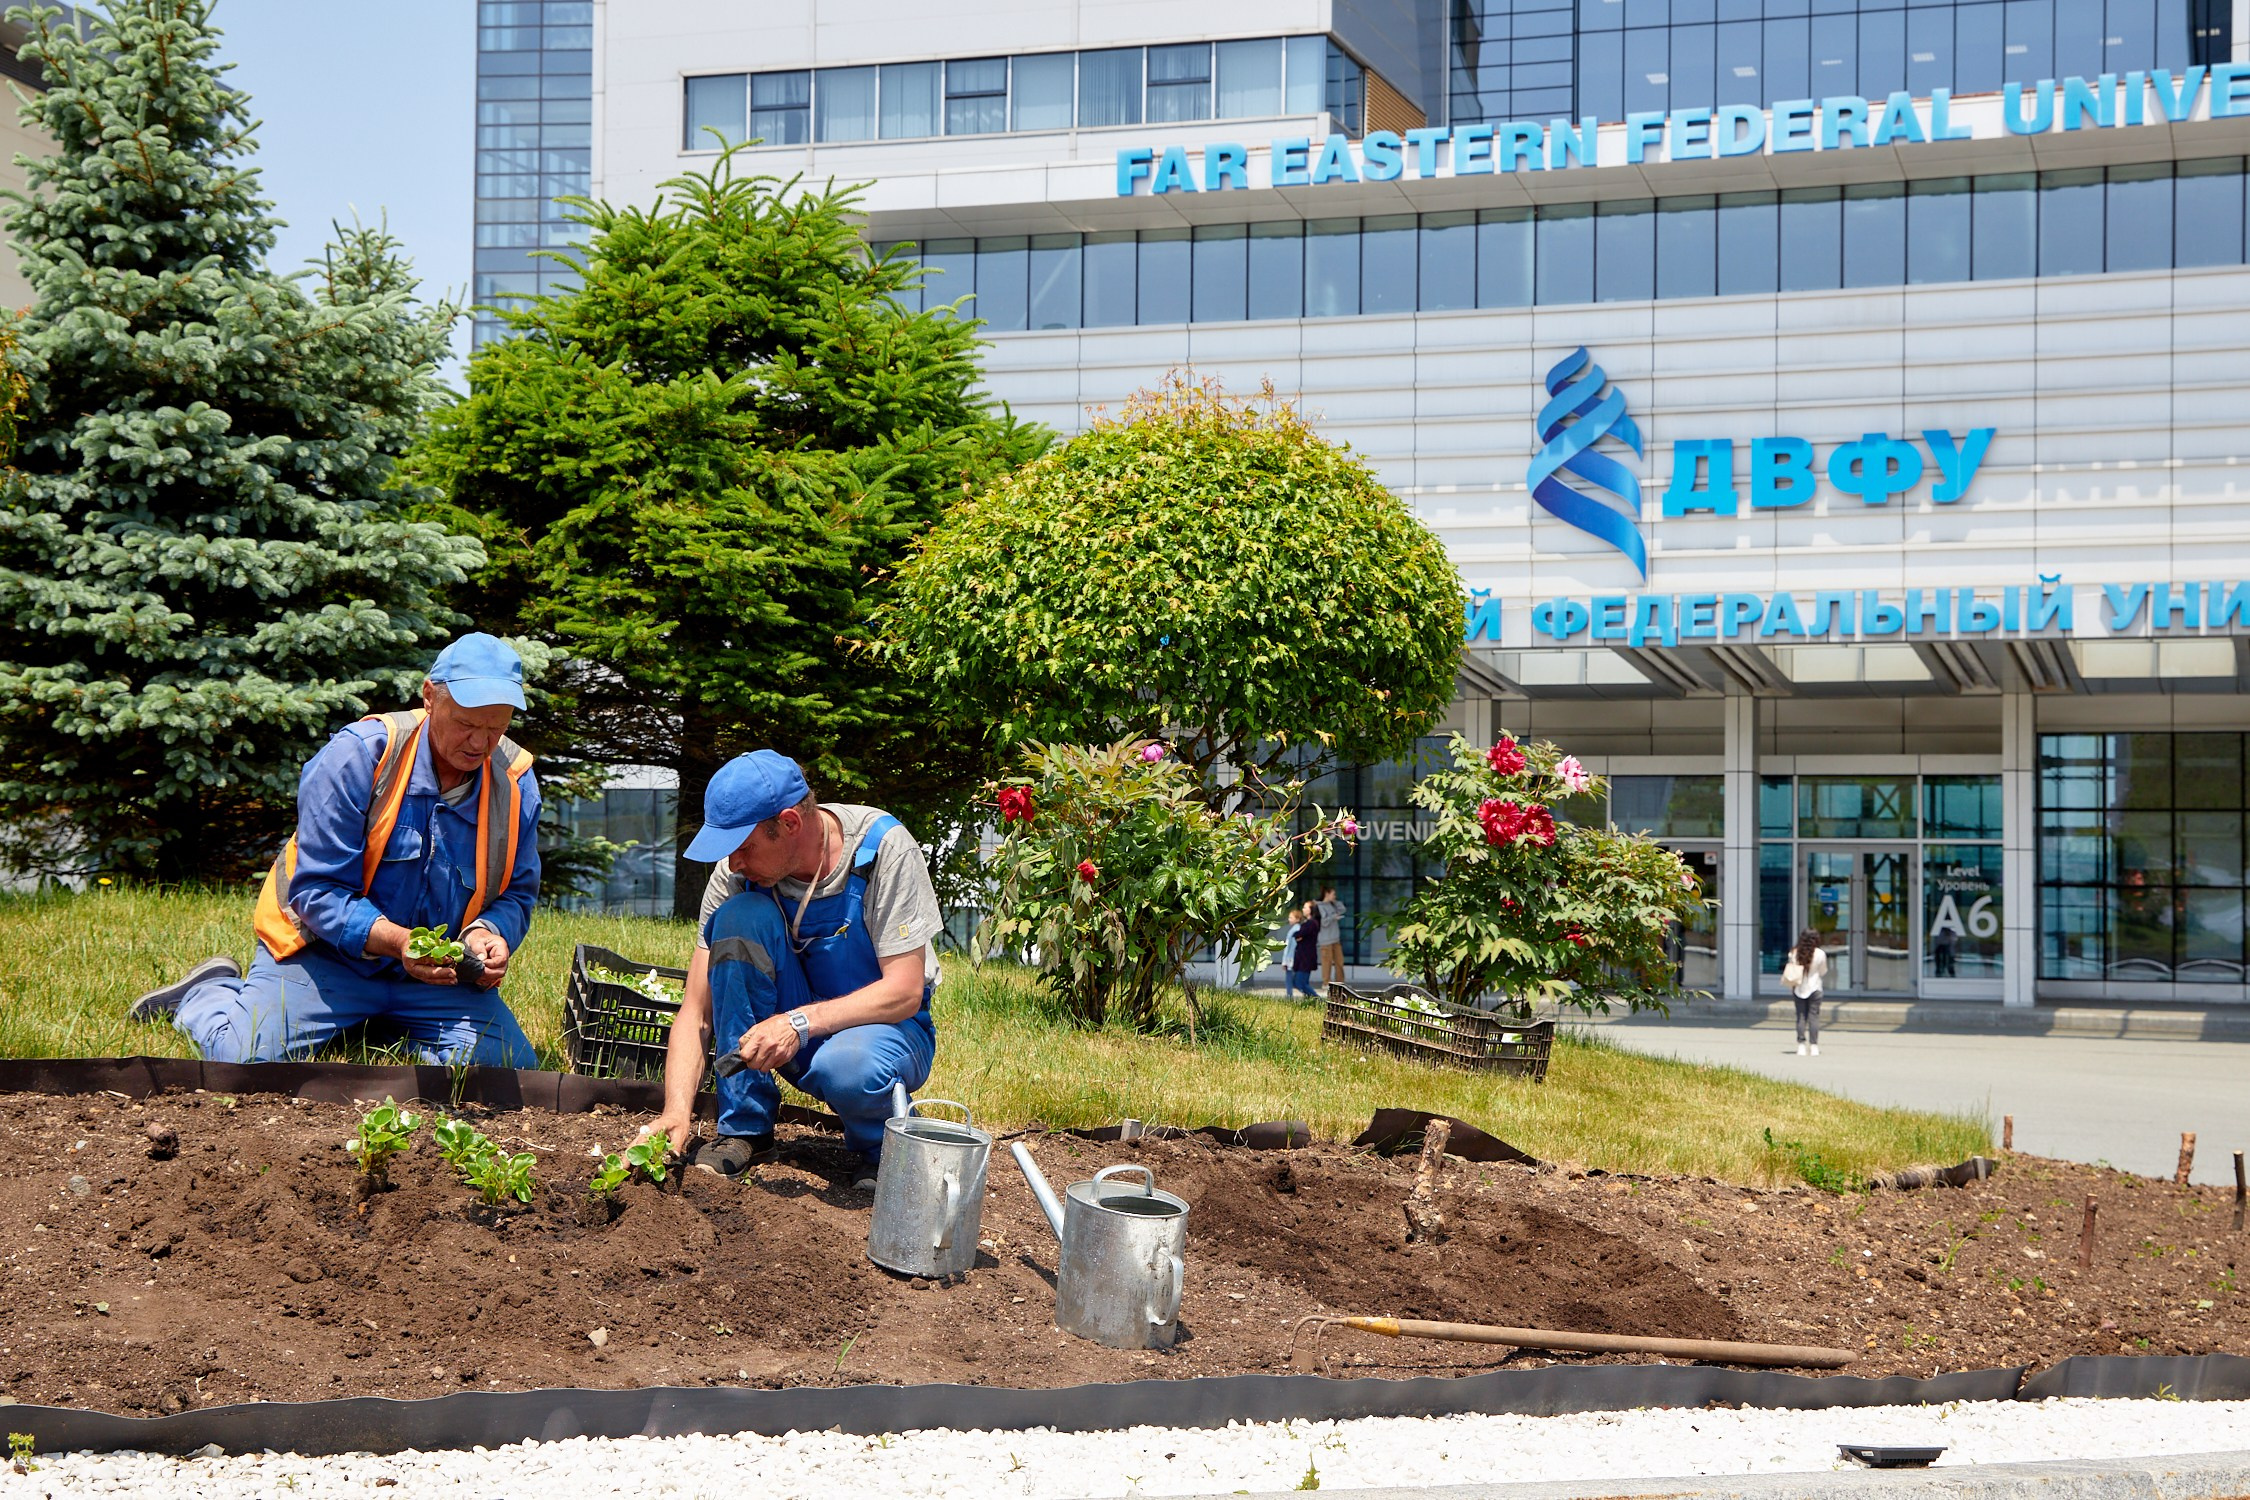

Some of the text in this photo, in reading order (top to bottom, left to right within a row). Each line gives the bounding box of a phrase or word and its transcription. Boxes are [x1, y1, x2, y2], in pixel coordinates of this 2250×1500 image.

[1117, 63, 2250, 196] FAR EASTERN FEDERAL UNIVE
[1662, 427, 1997, 517] ДВФУ
[1531, 573, 2074, 648] ФЕДЕРАЛЬНЫЙ
[2102, 580, 2250, 631] УНИ
[1937, 879, 1990, 893] Уровень
[1946, 865, 1981, 877] Level
